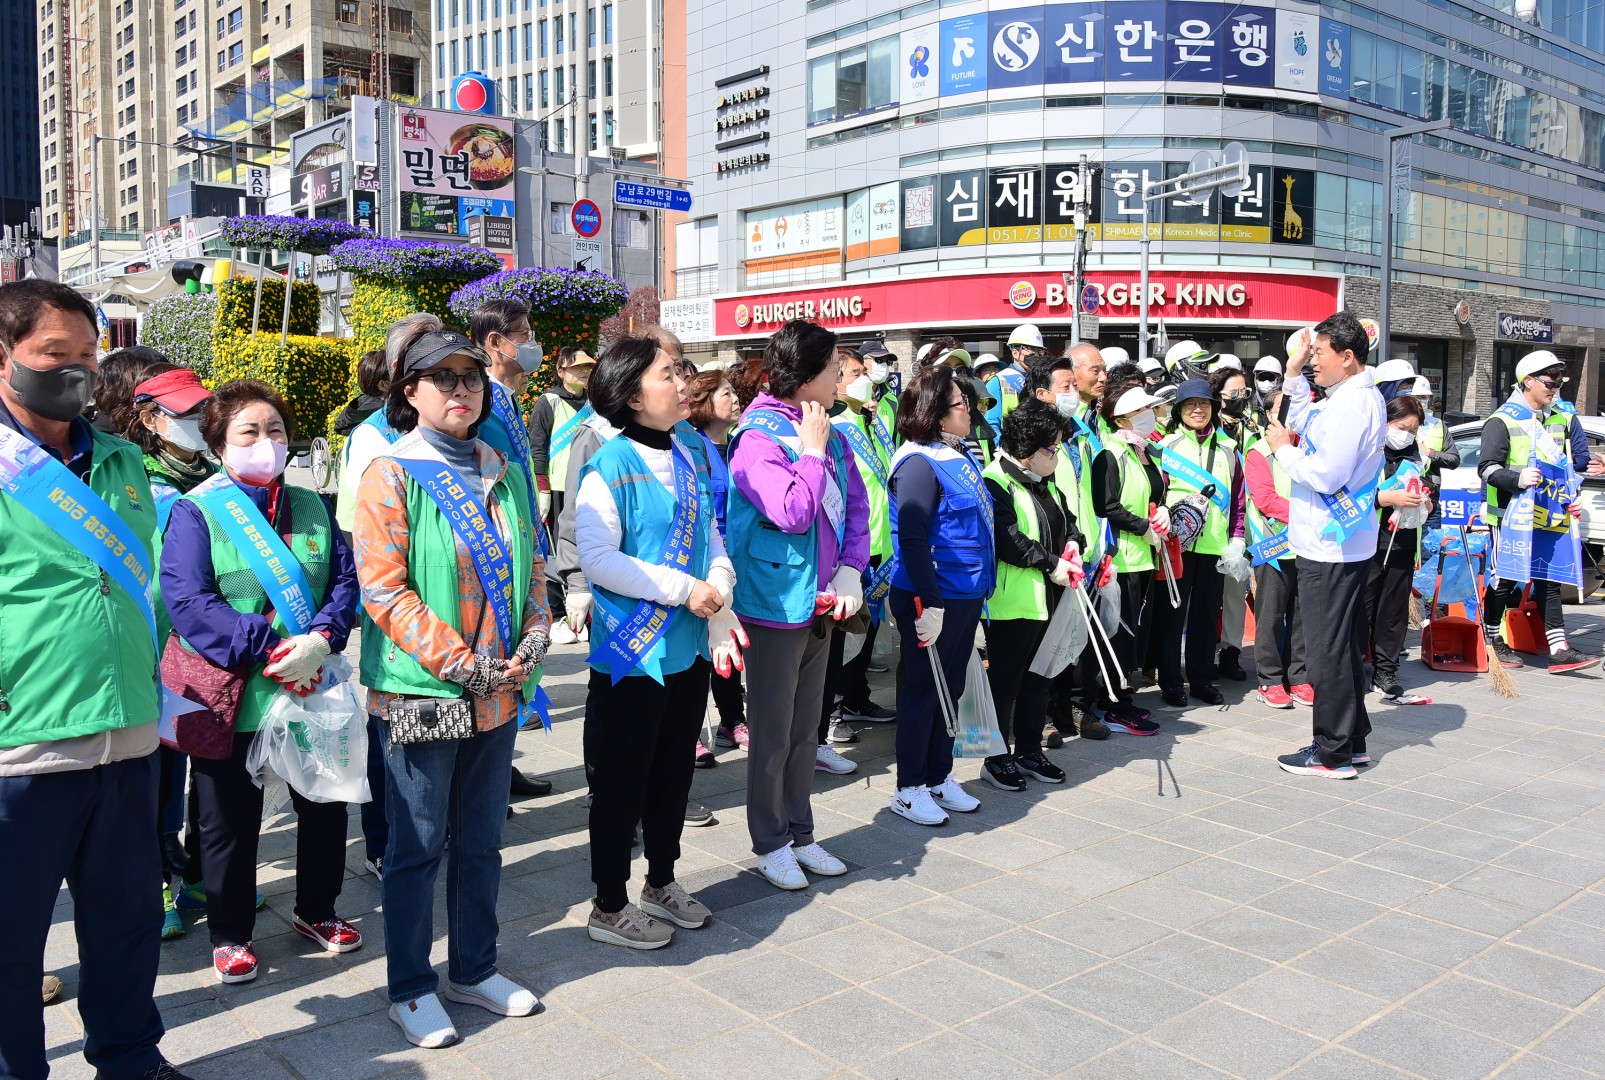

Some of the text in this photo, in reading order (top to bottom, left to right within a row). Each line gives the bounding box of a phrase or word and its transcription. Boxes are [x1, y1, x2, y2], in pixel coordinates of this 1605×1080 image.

[1055, 19, 1268, 65] 신한은행
[952, 70, 976, 80] FUTURE
[1290, 68, 1305, 76] HOPE
[1326, 75, 1342, 84] DREAM
[361, 166, 376, 180] S
[403, 147, 472, 190] 밀면
[251, 169, 263, 196] BAR
[358, 180, 380, 189] BAR
[617, 195, 643, 204] Gunam-ro
[487, 222, 510, 230] LIBERO
[993, 226, 1097, 241] 051.731.008
[1166, 228, 1193, 237] Korean
[1195, 228, 1233, 238] Medicine
[1233, 229, 1252, 238] Clinic
[576, 242, 600, 252] 견인지역
[1013, 286, 1031, 295] BURGER
[1013, 292, 1032, 302] KING
[1175, 282, 1246, 307] KING
[664, 303, 701, 317] 심재원한의원
[754, 295, 863, 325] BURGER KING
[1512, 319, 1540, 336] 신한은행
[847, 425, 862, 442] 구민
[436, 470, 510, 581] 구민 대청소의 날
[676, 470, 698, 567] 구민 대청소의 날
[48, 486, 147, 586] 주민이 참여하여 만드는
[428, 480, 492, 575] 2030세계박람회
[487, 578, 502, 602] 부산
[225, 500, 313, 629] 주민이 참여하여 만드는 깨끗한
[618, 604, 652, 641] 원합니다
